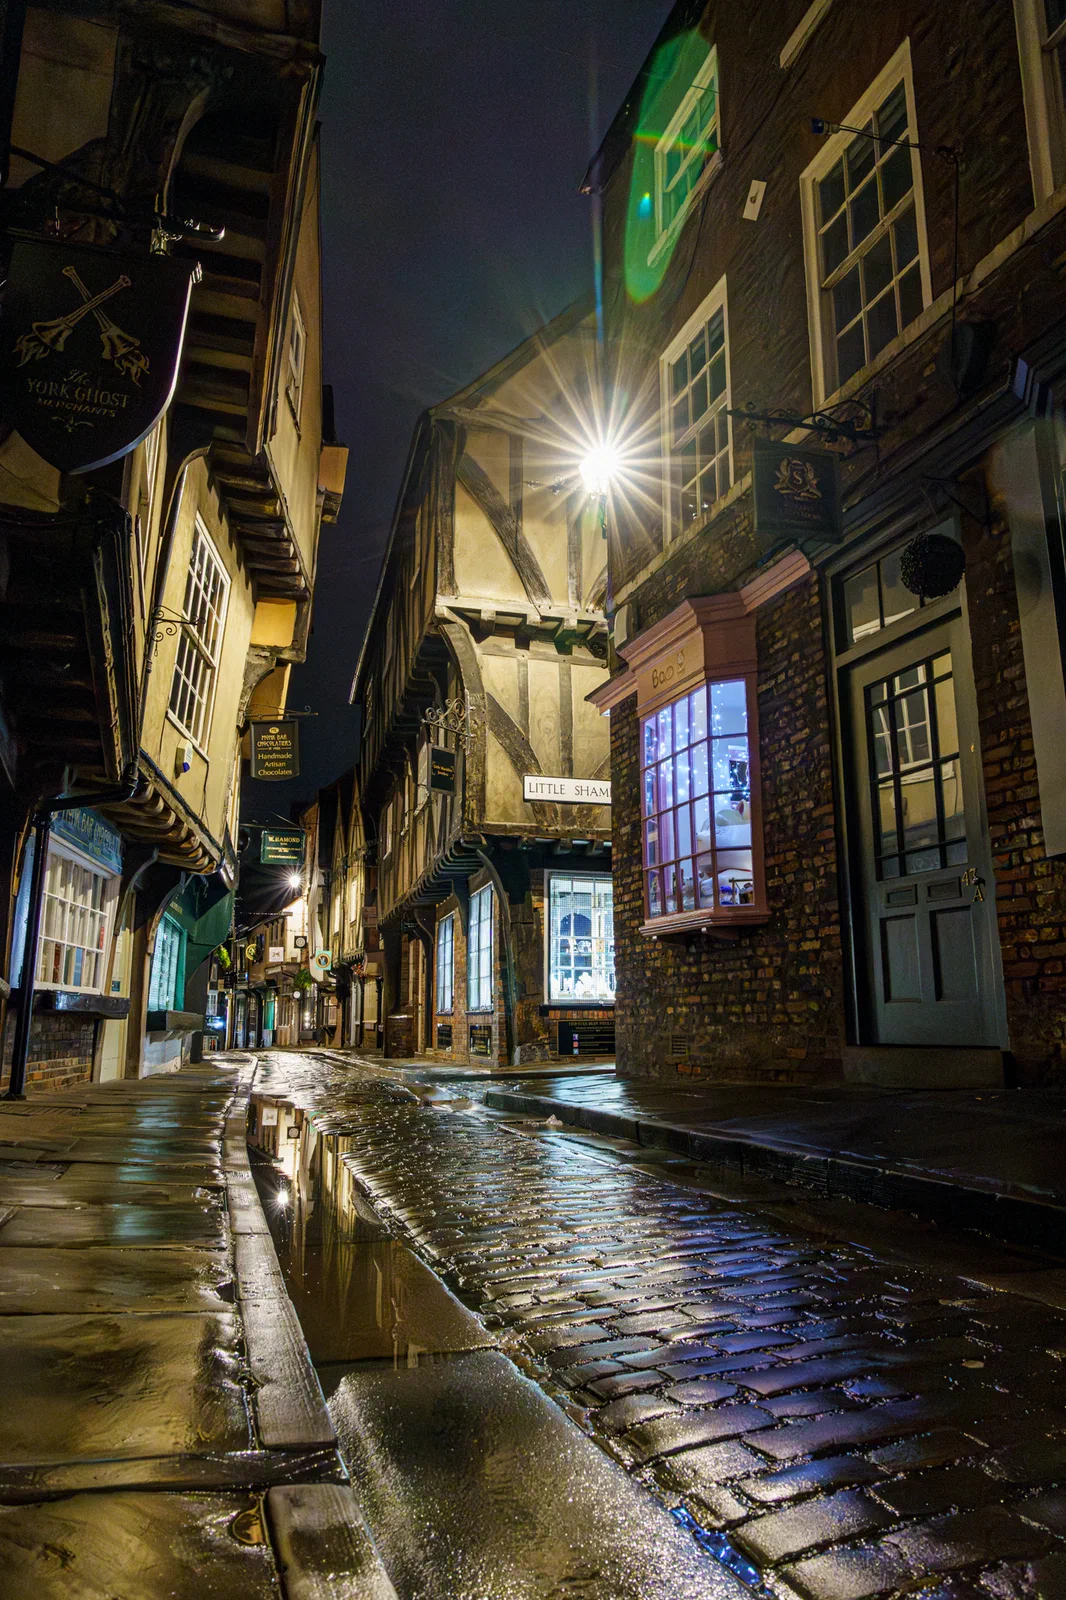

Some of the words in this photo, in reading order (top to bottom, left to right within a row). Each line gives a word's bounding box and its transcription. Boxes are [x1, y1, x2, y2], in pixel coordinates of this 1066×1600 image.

[27, 377, 70, 399] YORK
[74, 386, 130, 408] GHOST
[37, 398, 116, 418] MERCHANTS
[794, 471, 803, 484] S
[257, 752, 293, 760] Handmade
[257, 768, 293, 776] Chocolates
[528, 782, 566, 795] LITTLE
[972, 885, 984, 903] A
